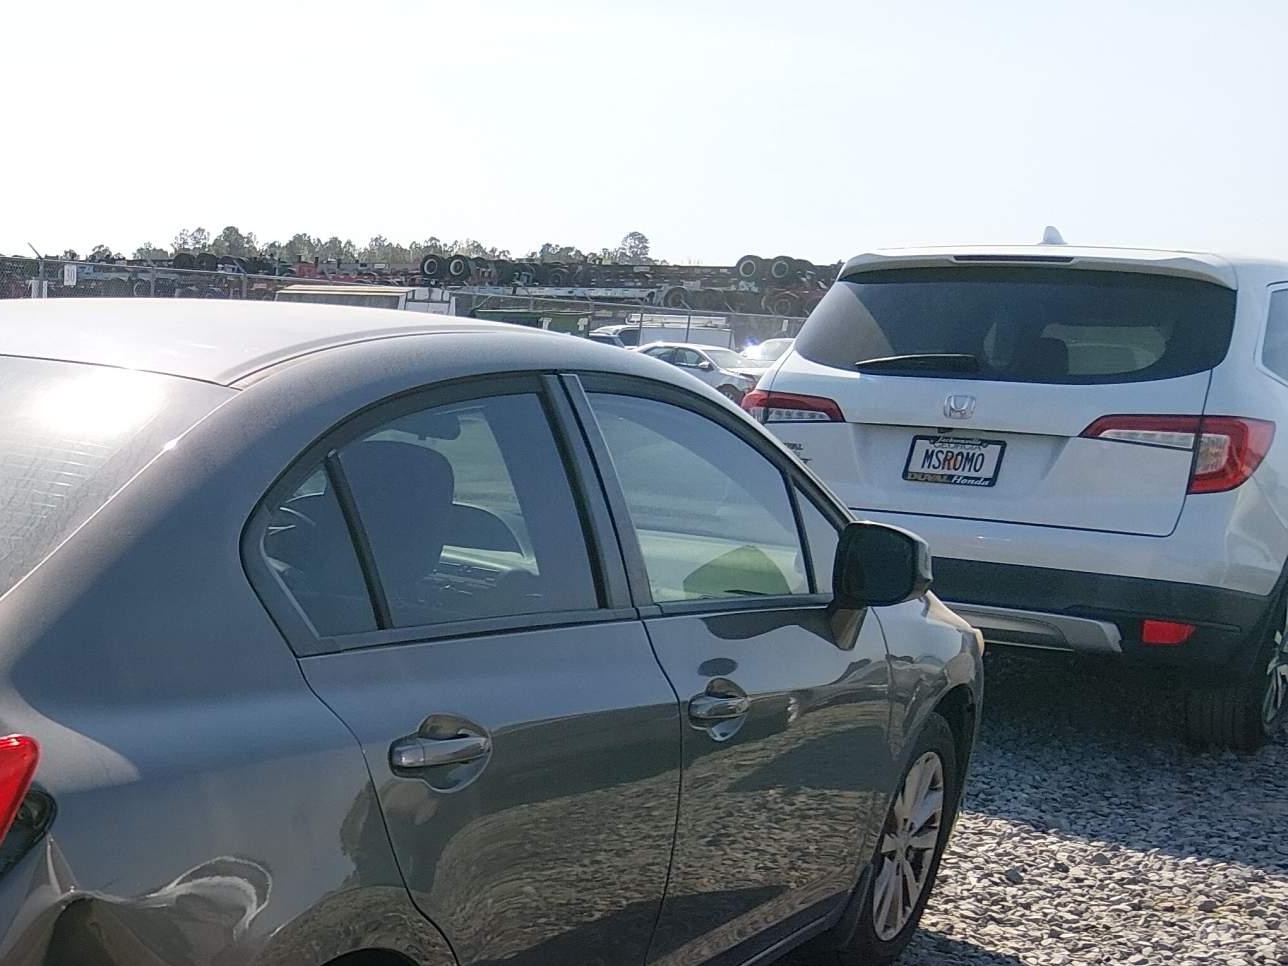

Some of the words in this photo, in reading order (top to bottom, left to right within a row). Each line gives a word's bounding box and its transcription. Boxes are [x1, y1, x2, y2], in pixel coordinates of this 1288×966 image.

[921, 449, 985, 473] MSROMO
[908, 472, 950, 482] DUVAL
[951, 475, 991, 486] Honda
